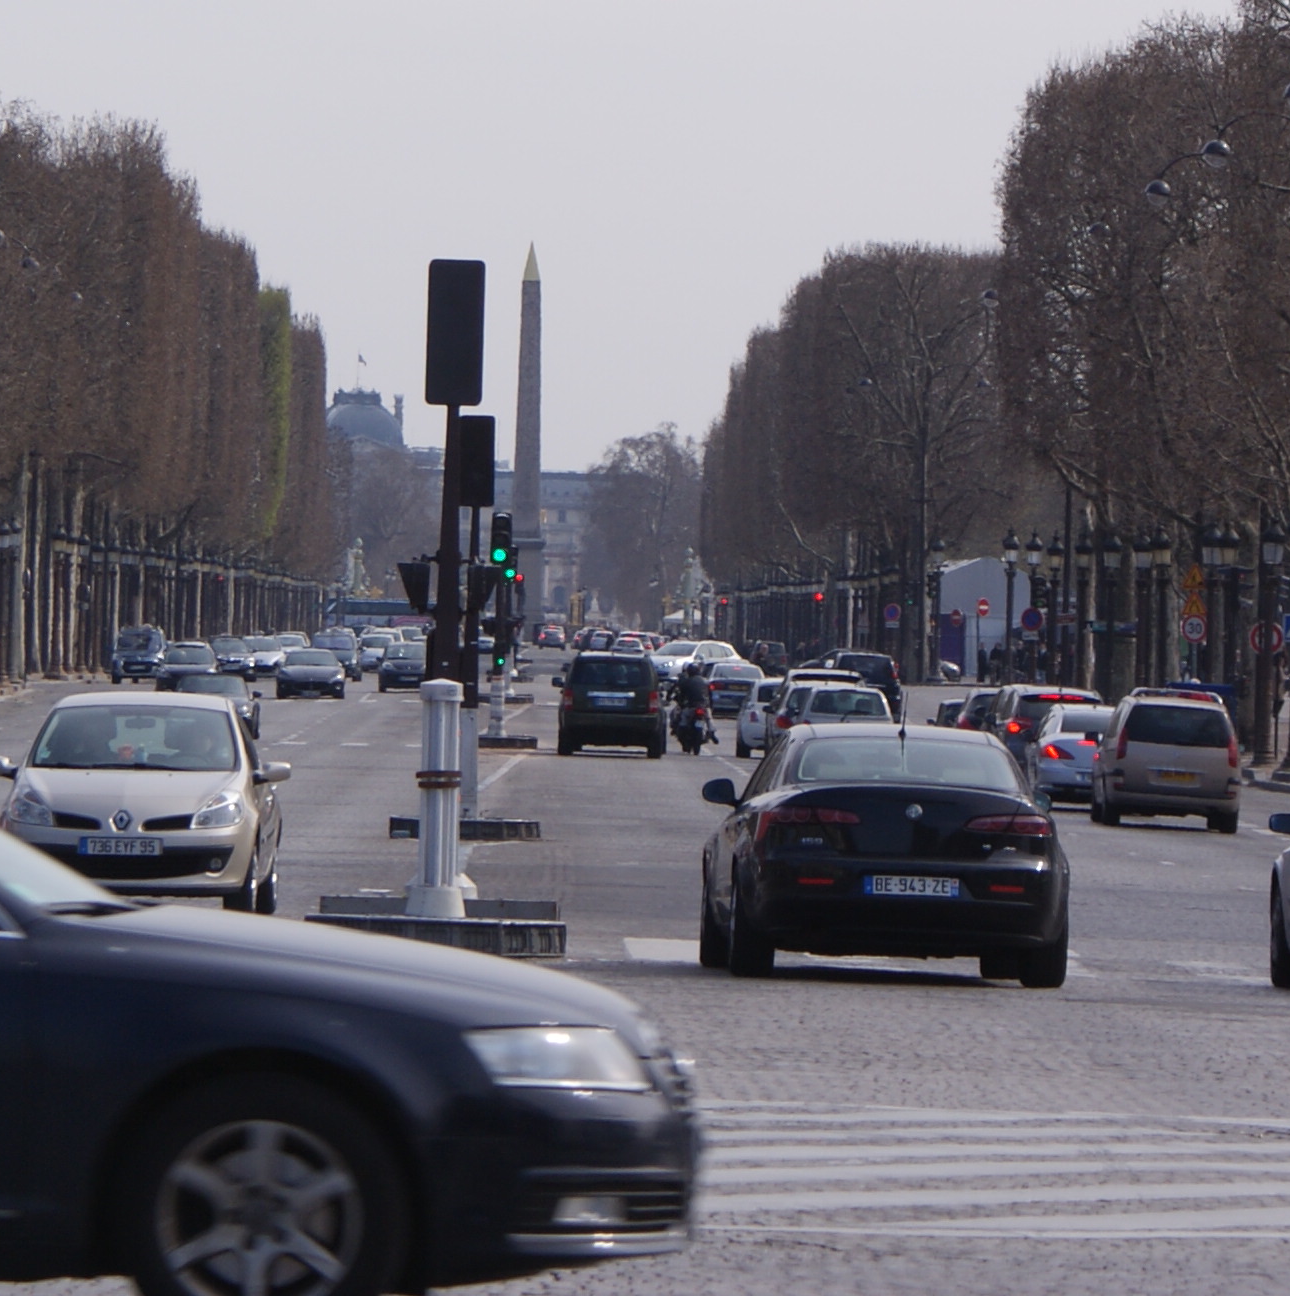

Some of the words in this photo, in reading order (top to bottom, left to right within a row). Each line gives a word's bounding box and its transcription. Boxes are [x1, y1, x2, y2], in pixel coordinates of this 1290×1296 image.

[1187, 622, 1202, 634] 30
[90, 839, 112, 854] 736
[114, 839, 136, 854] EYF
[139, 839, 155, 854] 95
[874, 876, 950, 894] BE-943-ZE
